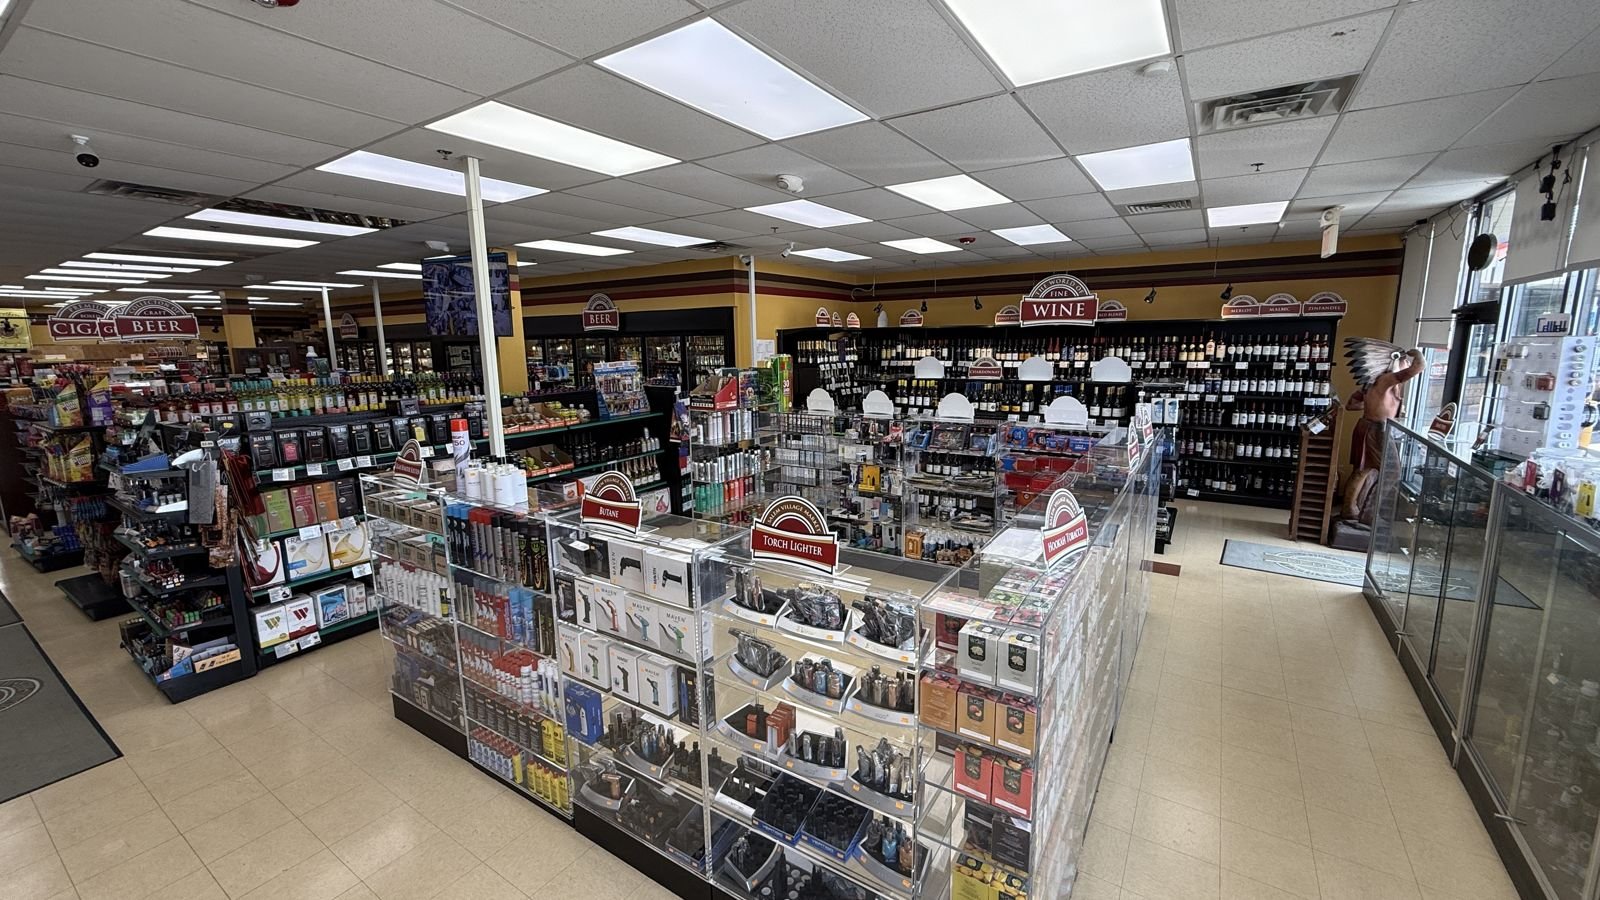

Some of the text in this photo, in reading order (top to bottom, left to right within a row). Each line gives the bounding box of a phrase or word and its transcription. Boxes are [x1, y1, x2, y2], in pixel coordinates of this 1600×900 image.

[1036, 278, 1084, 295] THE WORLD OF
[171, 306, 181, 314] OF
[1033, 302, 1085, 317] WINE
[590, 313, 612, 324] BEER
[132, 320, 183, 332] BEER
[599, 506, 619, 518] BUTANE
[767, 504, 822, 532] SALEM VILLAGE MARKET
[762, 534, 823, 556] TORCH LIGHTER
[1047, 536, 1066, 553] HOOKAH
[601, 588, 617, 596] MAVEN
[632, 602, 651, 612] MAVEN
[666, 613, 686, 623] MAVEN
